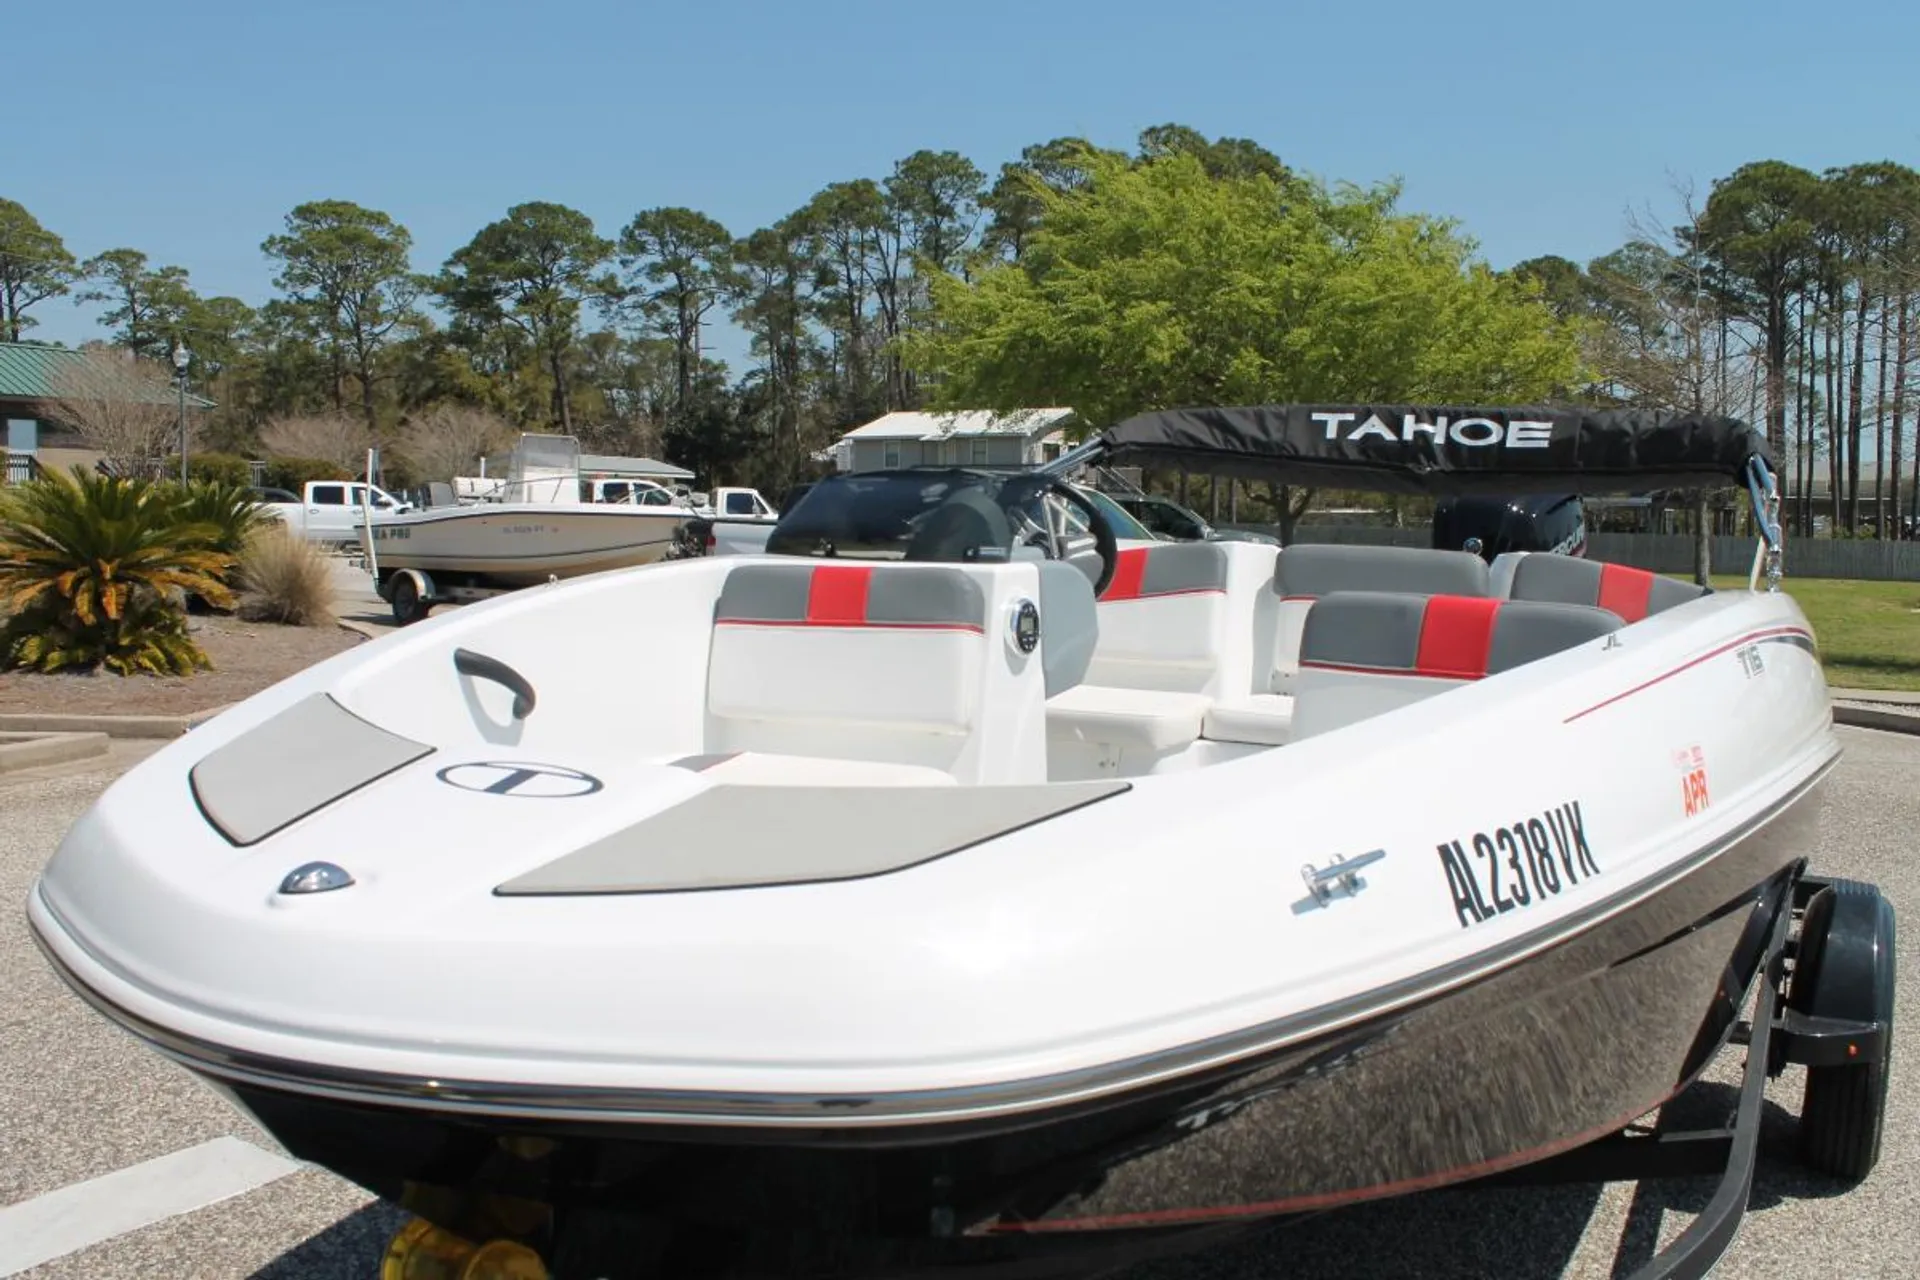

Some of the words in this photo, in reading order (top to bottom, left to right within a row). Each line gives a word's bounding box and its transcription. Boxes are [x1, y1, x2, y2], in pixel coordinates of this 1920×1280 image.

[1311, 412, 1553, 448] TAHOE
[1681, 769, 1709, 818] APR
[1436, 800, 1600, 928] AL2318VK
